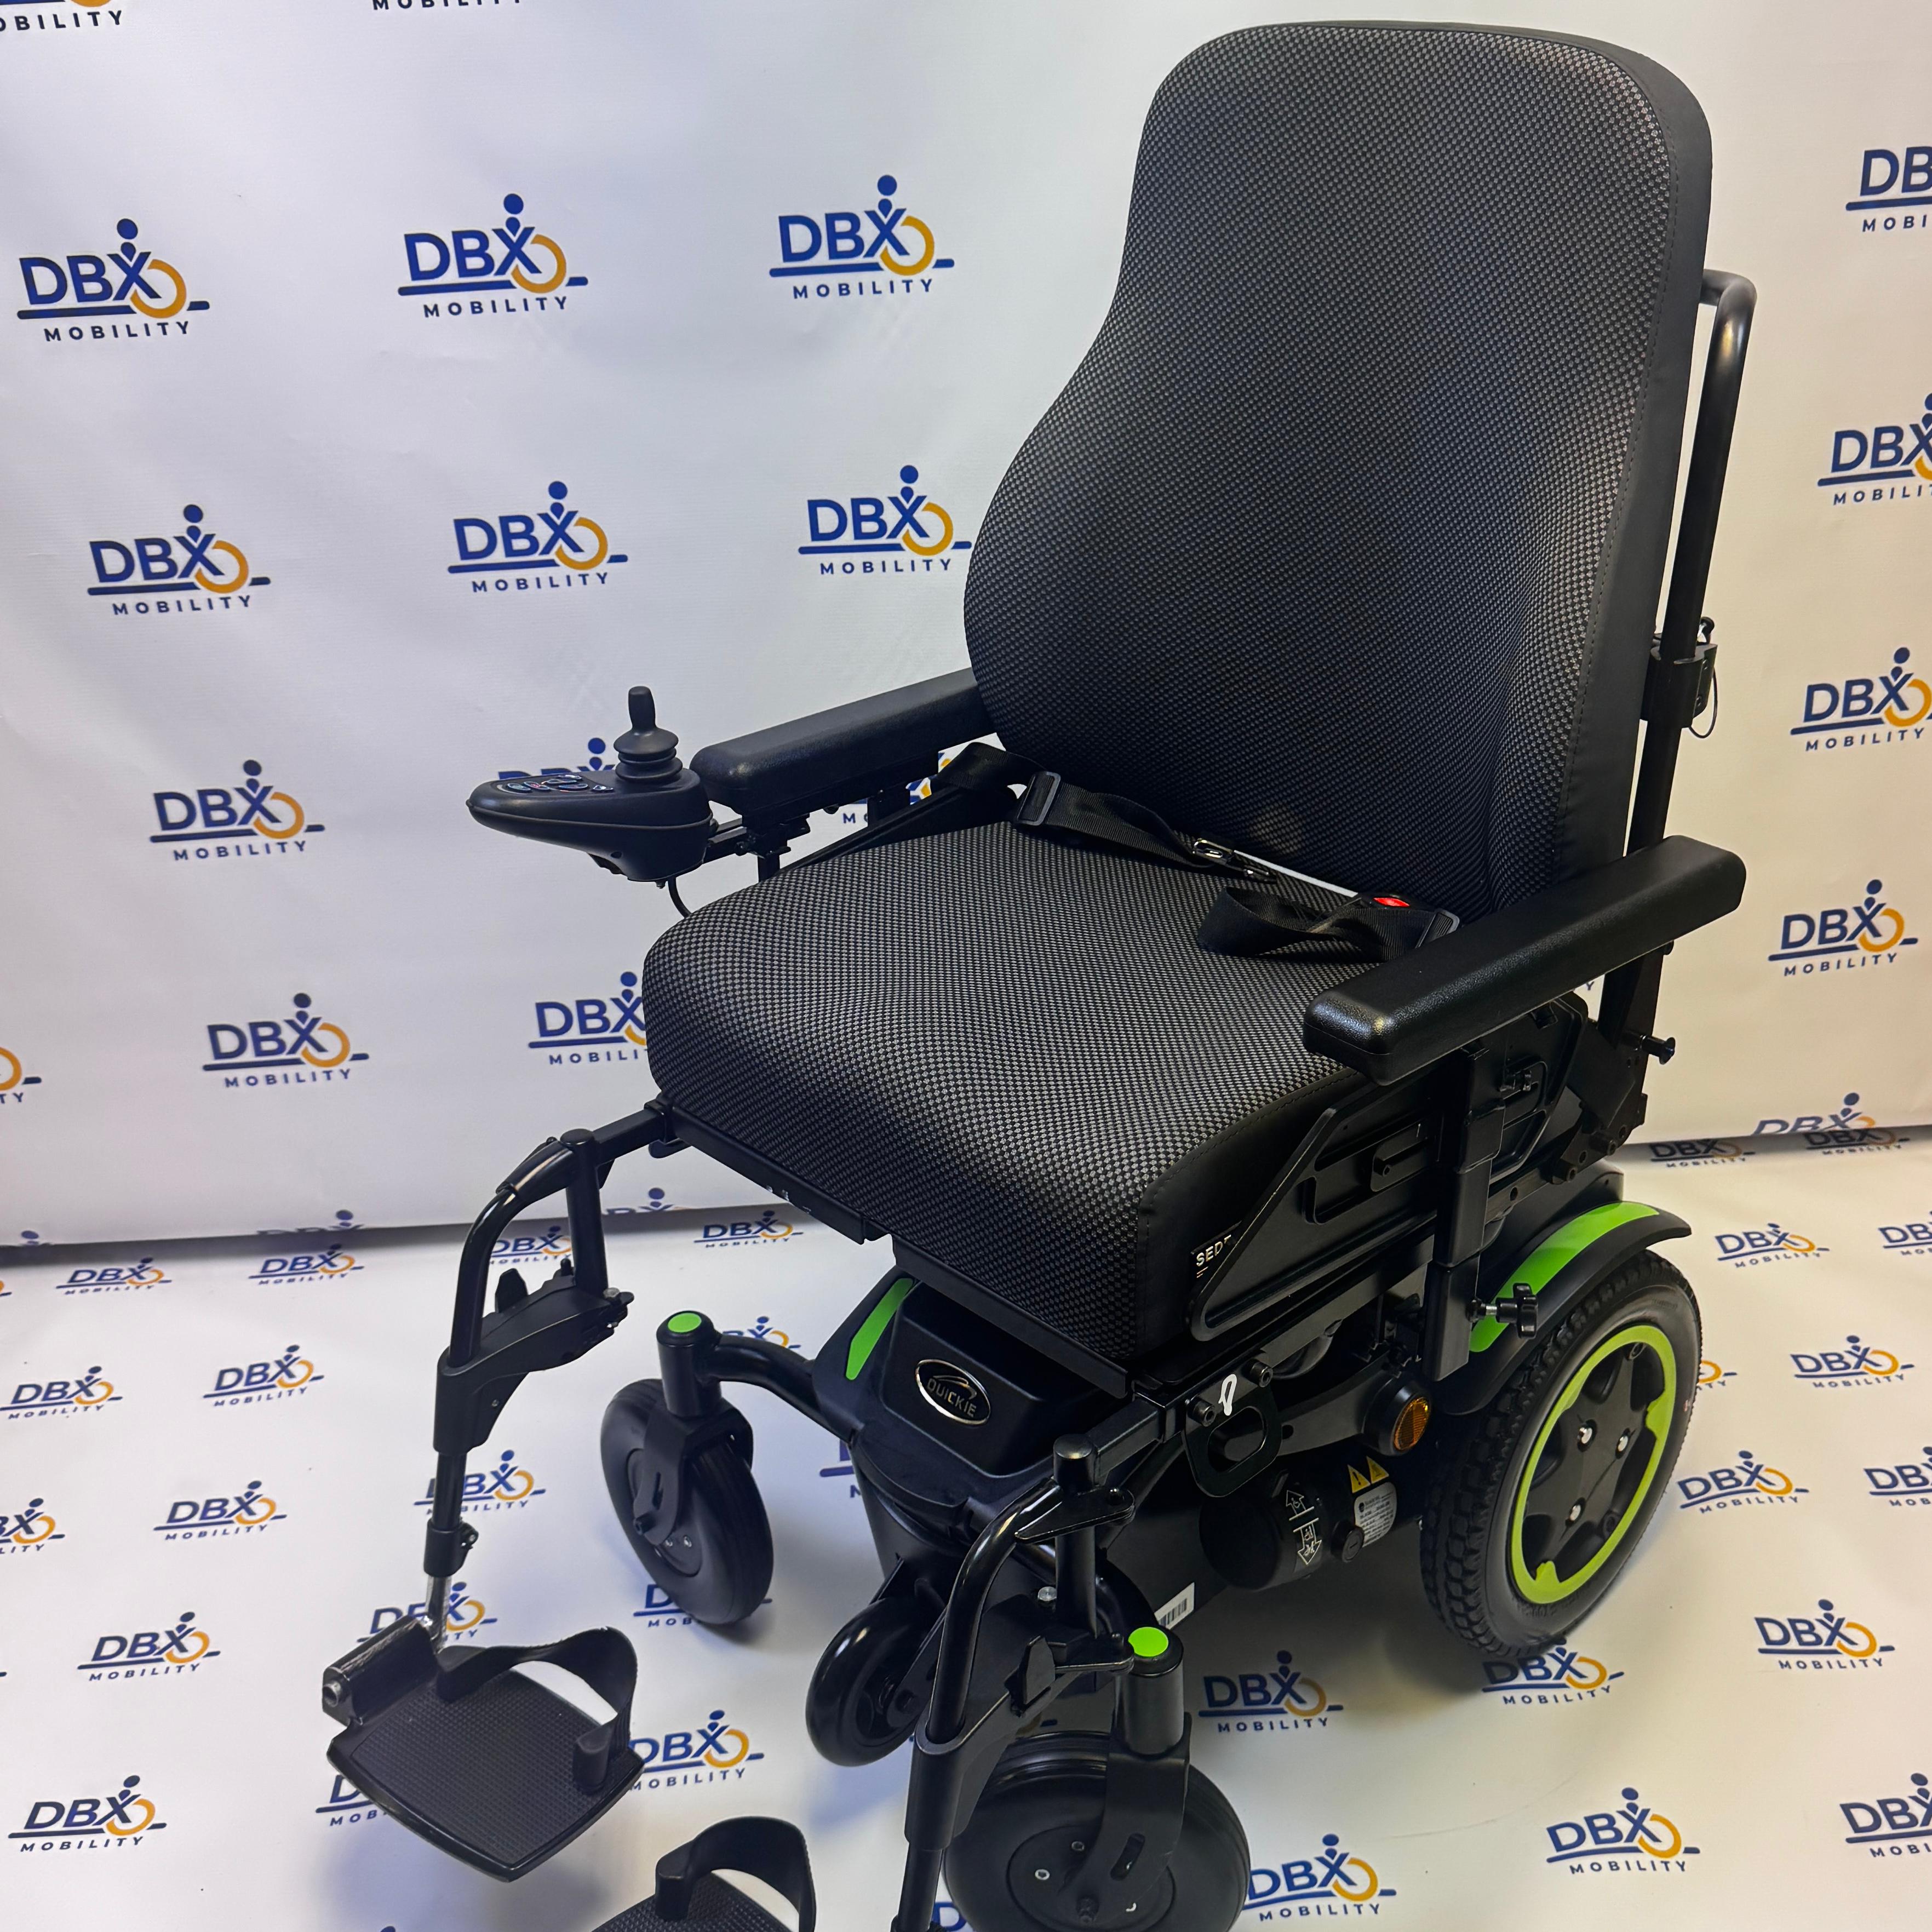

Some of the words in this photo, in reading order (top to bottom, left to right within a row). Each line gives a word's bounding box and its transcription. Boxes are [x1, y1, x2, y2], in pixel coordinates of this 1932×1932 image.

[778, 209, 909, 262] DBX
[404, 227, 542, 280] DBX
[19, 252, 161, 305] DBX
[793, 279, 933, 299] MOBILITY
[423, 296, 566, 318] MOBILITY
[45, 321, 190, 342] MOBILITY
[1833, 484, 1932, 505] MOBILI
[807, 495, 929, 541] DBX
[454, 510, 584, 560] DBX
[89, 534, 224, 583] DBX
[821, 559, 951, 575] MOBILITY
[472, 572, 609, 592] MOBILITY
[113, 595, 251, 615] MOBILITY
[1803, 673, 1914, 722] DBX
[1806, 727, 1924, 751] MOBILITY
[153, 786, 282, 830] DBX
[174, 840, 306, 861] MOBILITY
[1781, 903, 1885, 950] DBX
[1784, 953, 1897, 976] MOBILITY
[535, 999, 644, 1037] DBX
[207, 1017, 327, 1059] DBX
[549, 1048, 647, 1065] MOBILI
[224, 1069, 351, 1088] MOBILITY
[1649, 1139, 1725, 1157] DBX
[703, 1219, 778, 1239] DBX
[1878, 1222, 1932, 1243] DB
[705, 1238, 789, 1248] MOBILITY
[1715, 1228, 1799, 1255] DBX
[260, 1252, 341, 1272] DBX
[1735, 1251, 1820, 1268] MOBILITY
[67, 1265, 149, 1283] DBX
[1791, 1345, 1881, 1373] DBX
[214, 1356, 300, 1391] DBX
[1812, 1374, 1904, 1388] MOBILITY
[10, 1379, 100, 1404] DBX
[214, 1388, 307, 1406] MOBILITY
[927, 1378, 977, 1418] QUICKIE
[8, 1405, 104, 1419] MOBILITY
[1677, 1464, 1775, 1500] DBX
[1864, 1463, 1932, 1489] DB
[166, 1494, 263, 1523] DBX
[1700, 1497, 1798, 1514] MOBILITY
[165, 1524, 267, 1540] MOBILITY
[1755, 1617, 1858, 1646] DBX
[91, 1628, 196, 1661] DBX
[89, 1663, 200, 1681] MOBILITY
[1483, 1652, 1587, 1684] DBX
[1779, 1658, 1883, 1670] MOBILITY
[1203, 1672, 1306, 1707] DBX
[1503, 1686, 1610, 1704] MOBILITY
[1218, 1717, 1328, 1732] MOBILITY
[24, 1795, 141, 1830] DBX
[1547, 1808, 1661, 1852] DBX
[20, 1836, 143, 1851] MOBILITY
[1247, 1852, 1356, 1900] DBX
[1569, 1860, 1687, 1874] MOBILITY
[1259, 1903, 1380, 1921] MOBILITY
